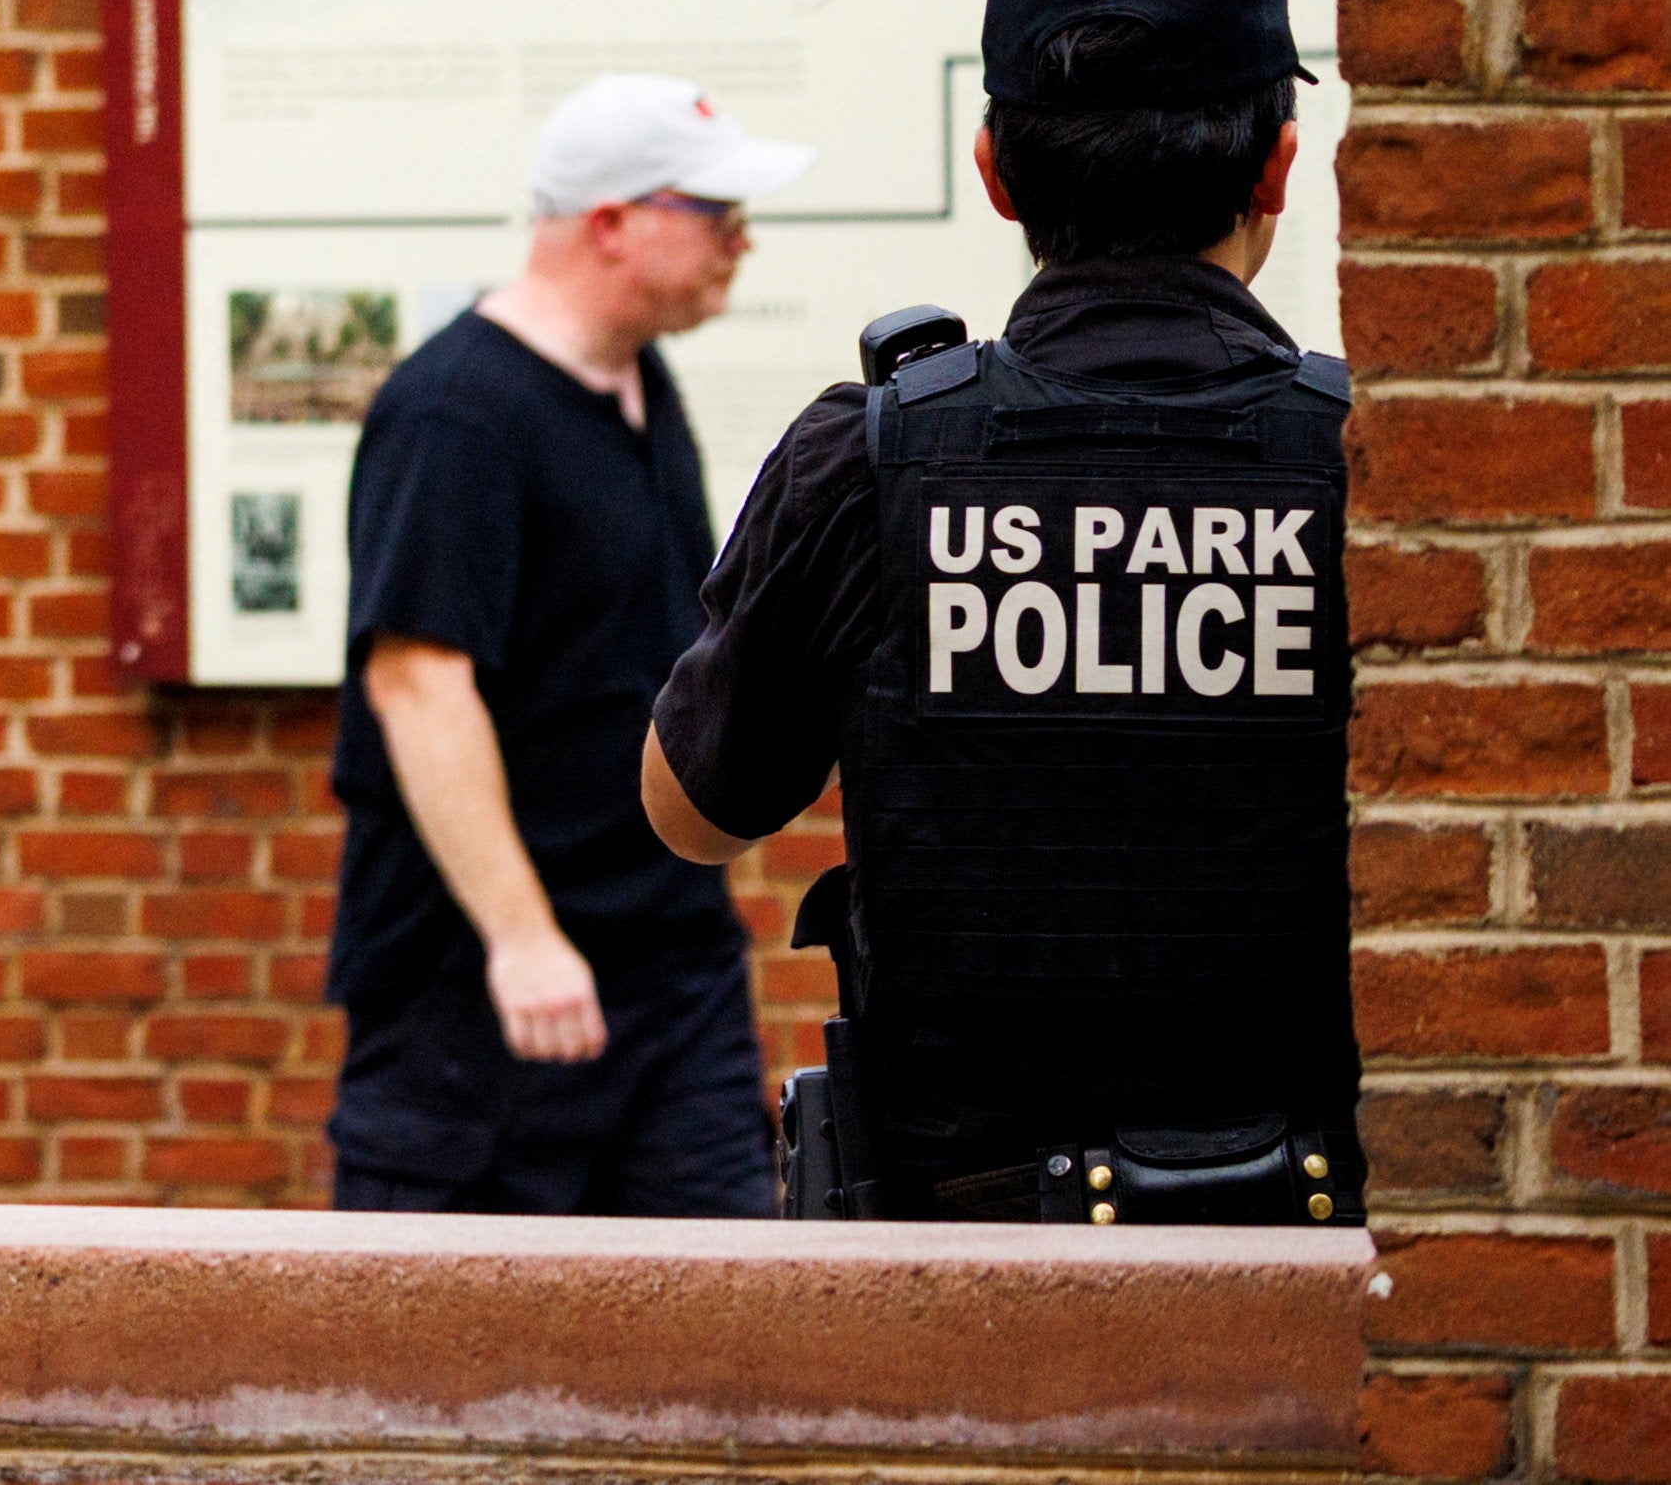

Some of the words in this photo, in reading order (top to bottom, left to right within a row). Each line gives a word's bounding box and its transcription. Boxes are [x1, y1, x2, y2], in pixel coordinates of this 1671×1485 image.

[929, 505, 1042, 574] US
[1074, 507, 1315, 576] PARK
[929, 581, 1315, 697] POLICE
